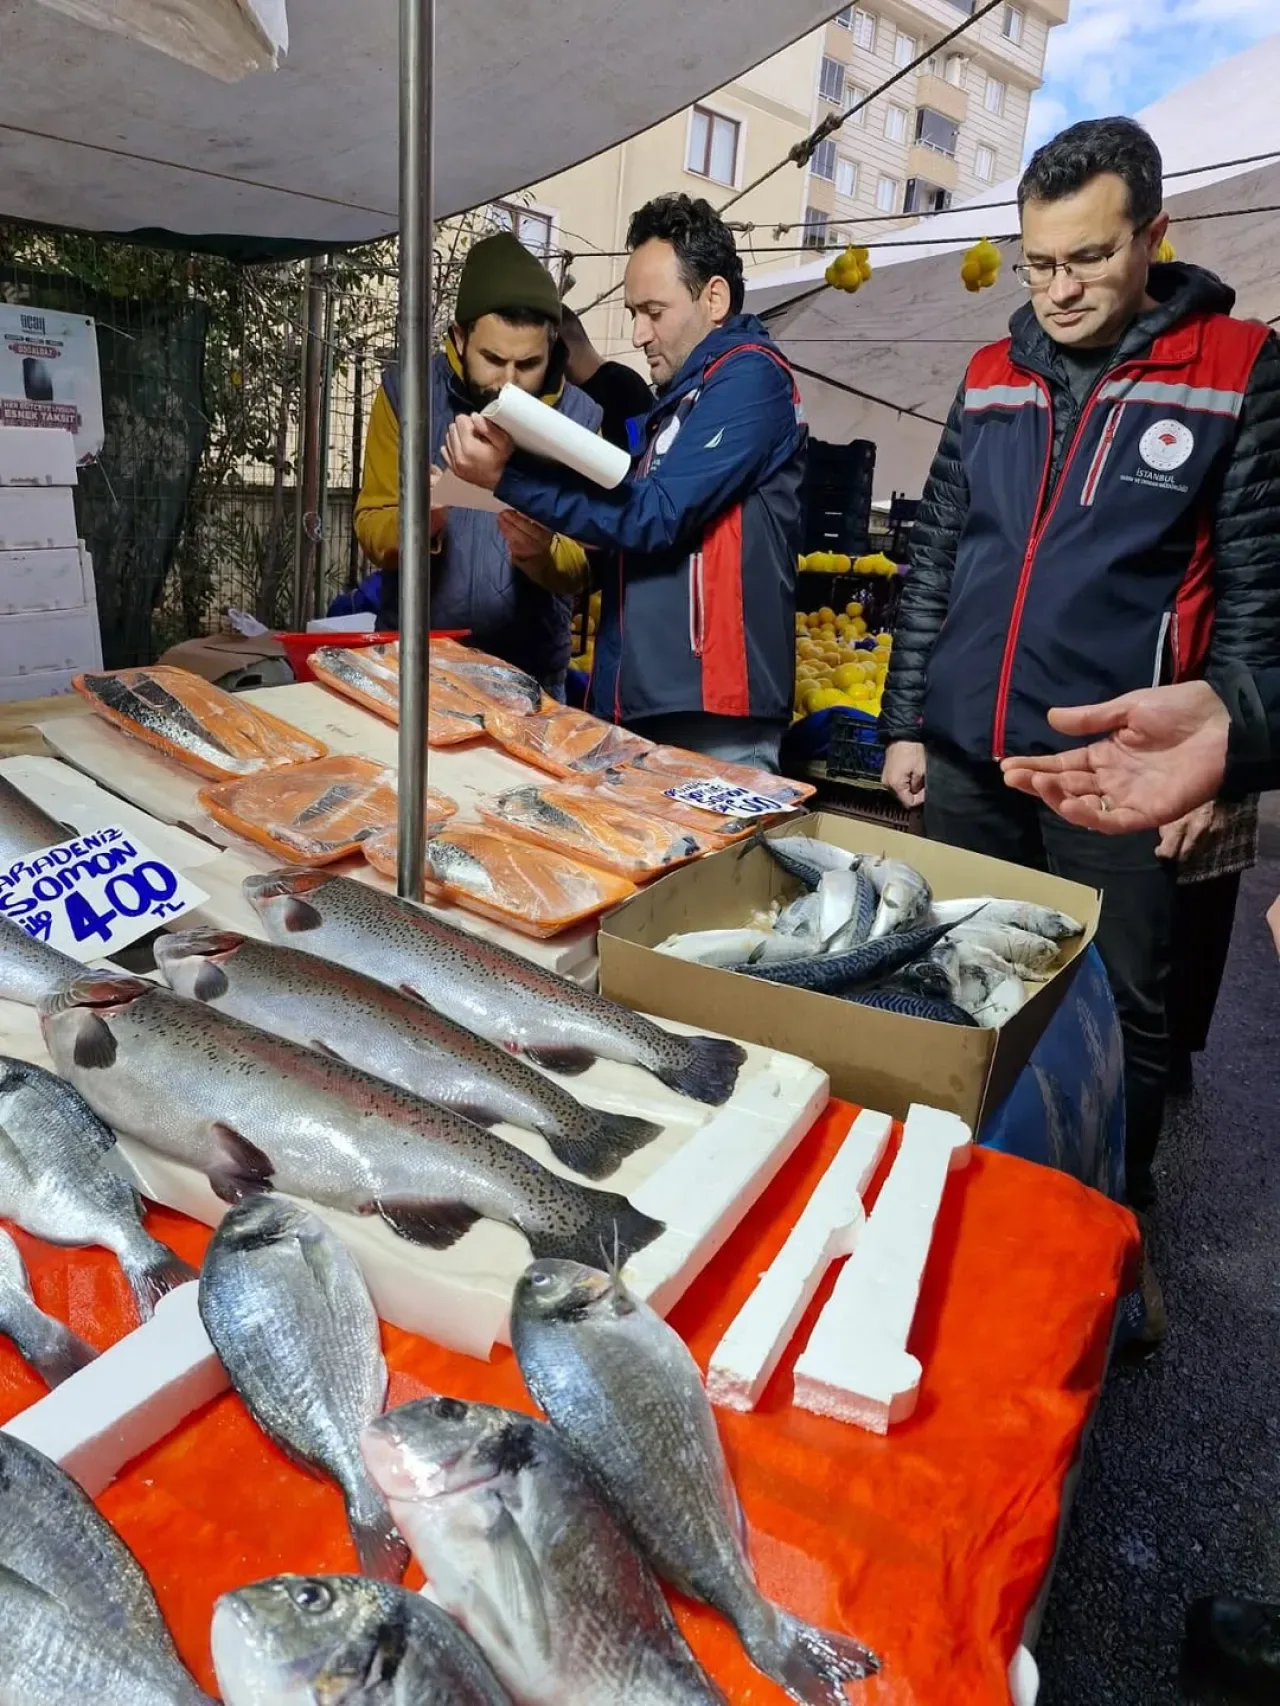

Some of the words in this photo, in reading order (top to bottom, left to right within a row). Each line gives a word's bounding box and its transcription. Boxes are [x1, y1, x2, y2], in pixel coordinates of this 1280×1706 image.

[1136, 467, 1176, 483] İSTANBUL
[0, 828, 123, 893] ARADENİZ
[0, 841, 138, 917] SOMON
[65, 861, 178, 943] 400
[151, 901, 186, 918] TL
